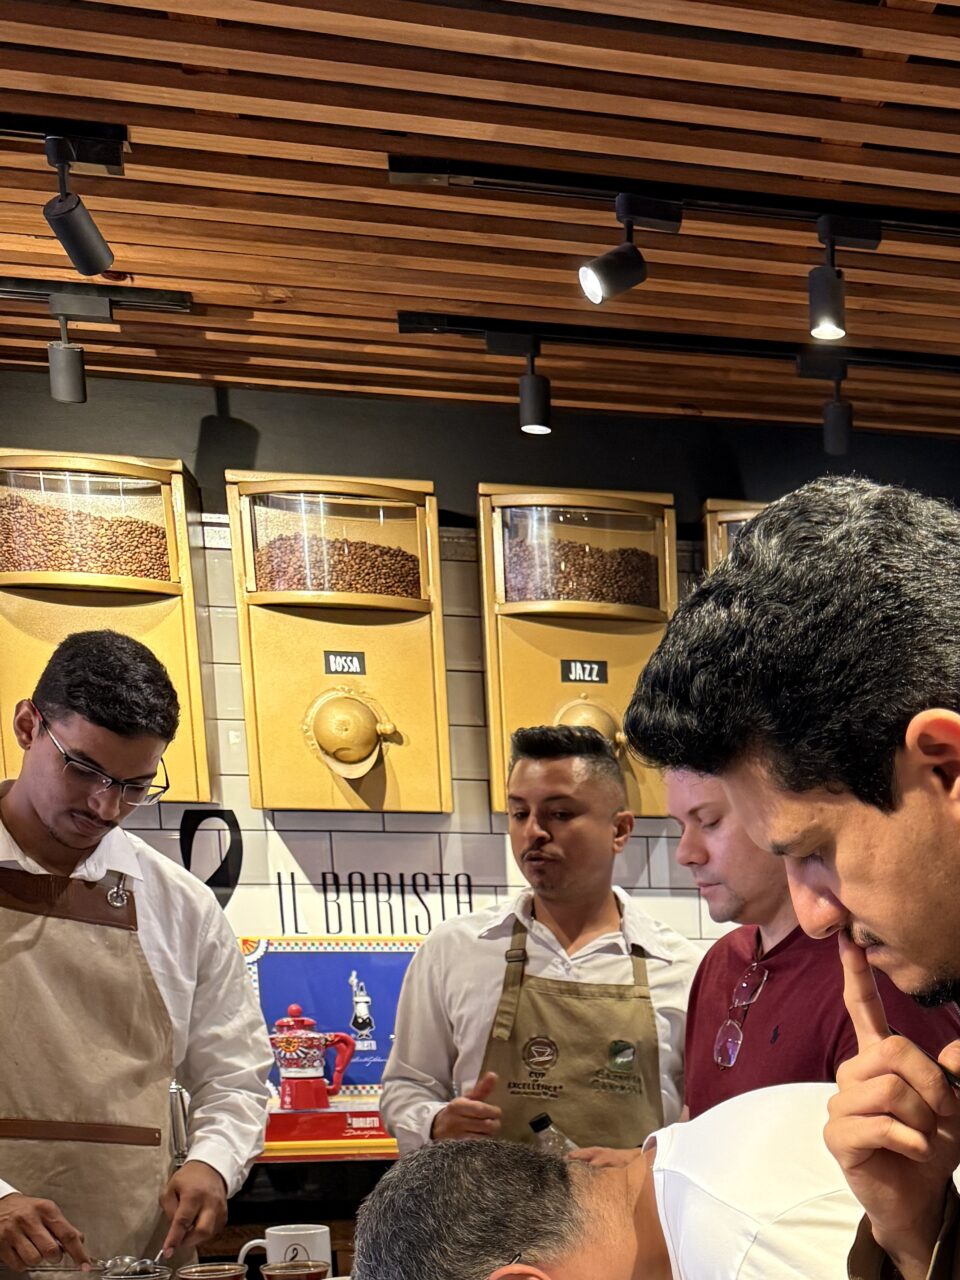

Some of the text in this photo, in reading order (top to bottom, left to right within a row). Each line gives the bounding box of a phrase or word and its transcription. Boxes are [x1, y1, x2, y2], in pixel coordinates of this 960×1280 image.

[329, 655, 361, 672] BOSSA
[569, 662, 600, 681] JAZZ
[277, 871, 473, 937] IL BARISTA
